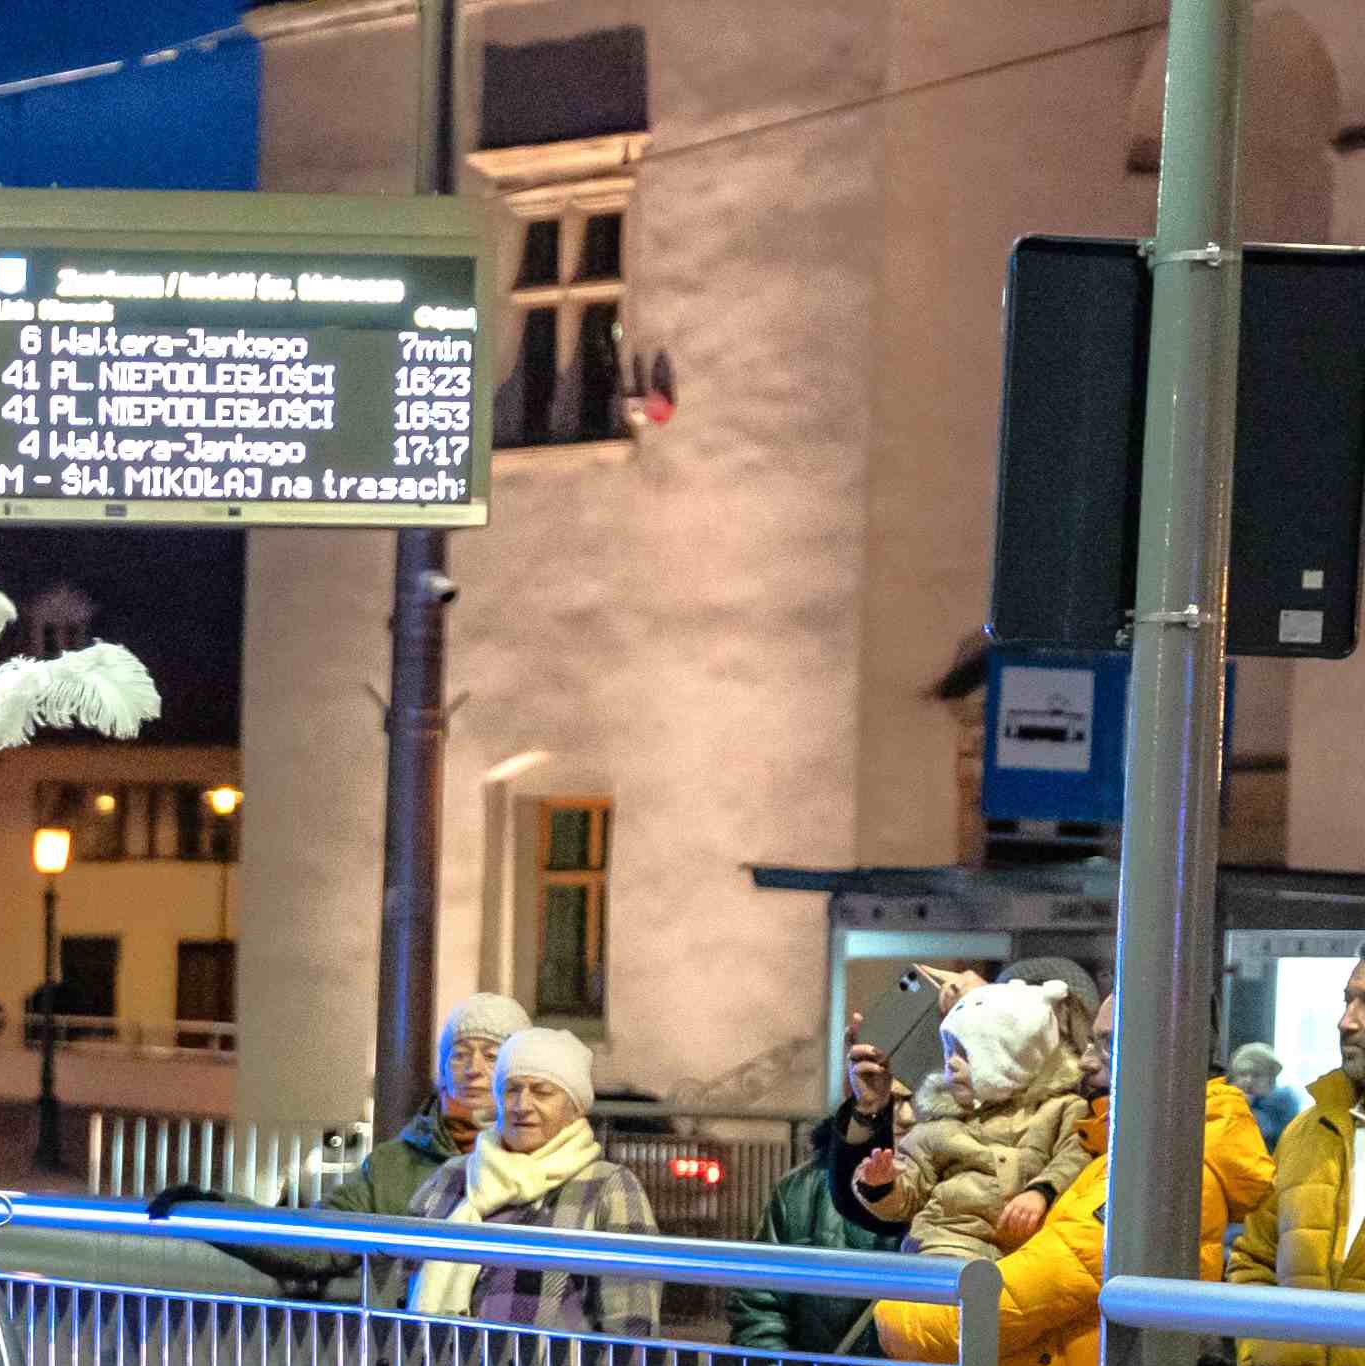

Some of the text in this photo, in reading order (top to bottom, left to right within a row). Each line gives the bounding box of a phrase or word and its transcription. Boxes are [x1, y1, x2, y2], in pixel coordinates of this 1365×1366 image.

[20, 325, 472, 362] 6 Waltera-Jankego 7min
[1, 360, 471, 397] 41 PL. NIEPODLEGŁOŚCI 16:23
[1, 395, 470, 431] 41 PL. NIEPODLEGŁOŚCI 16:53
[18, 430, 470, 467] 4 Waltera-Jankego 17:17
[60, 462, 116, 497] ŚW.
[124, 466, 263, 498] MIKOŁAJ
[270, 476, 313, 499] na
[322, 468, 467, 501] trasach:
